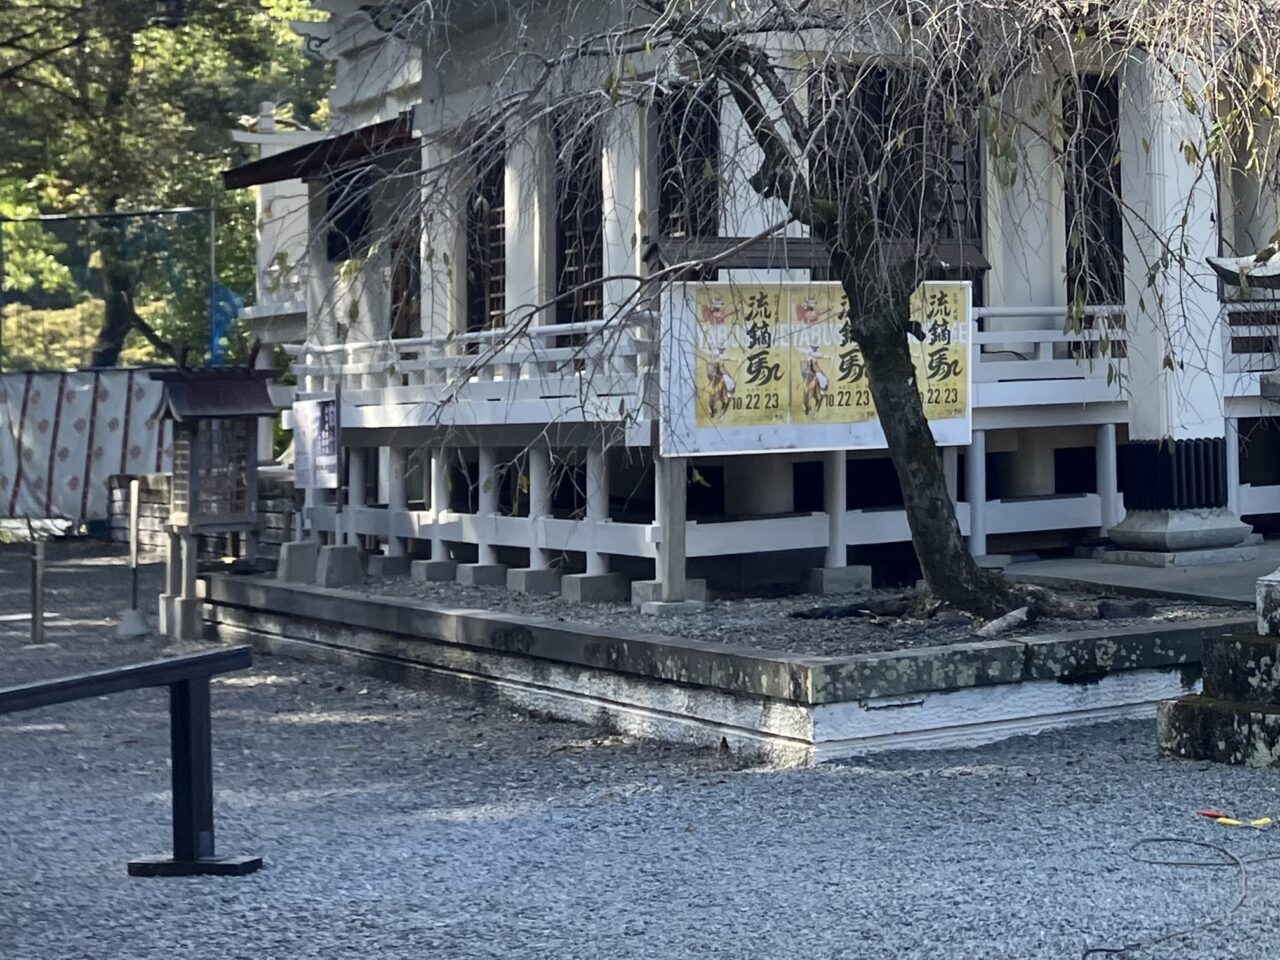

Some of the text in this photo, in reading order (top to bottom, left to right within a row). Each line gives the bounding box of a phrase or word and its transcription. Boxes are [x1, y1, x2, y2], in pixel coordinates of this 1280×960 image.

[745, 291, 784, 387] 流鏑馬
[926, 290, 963, 382] 流鏑馬
